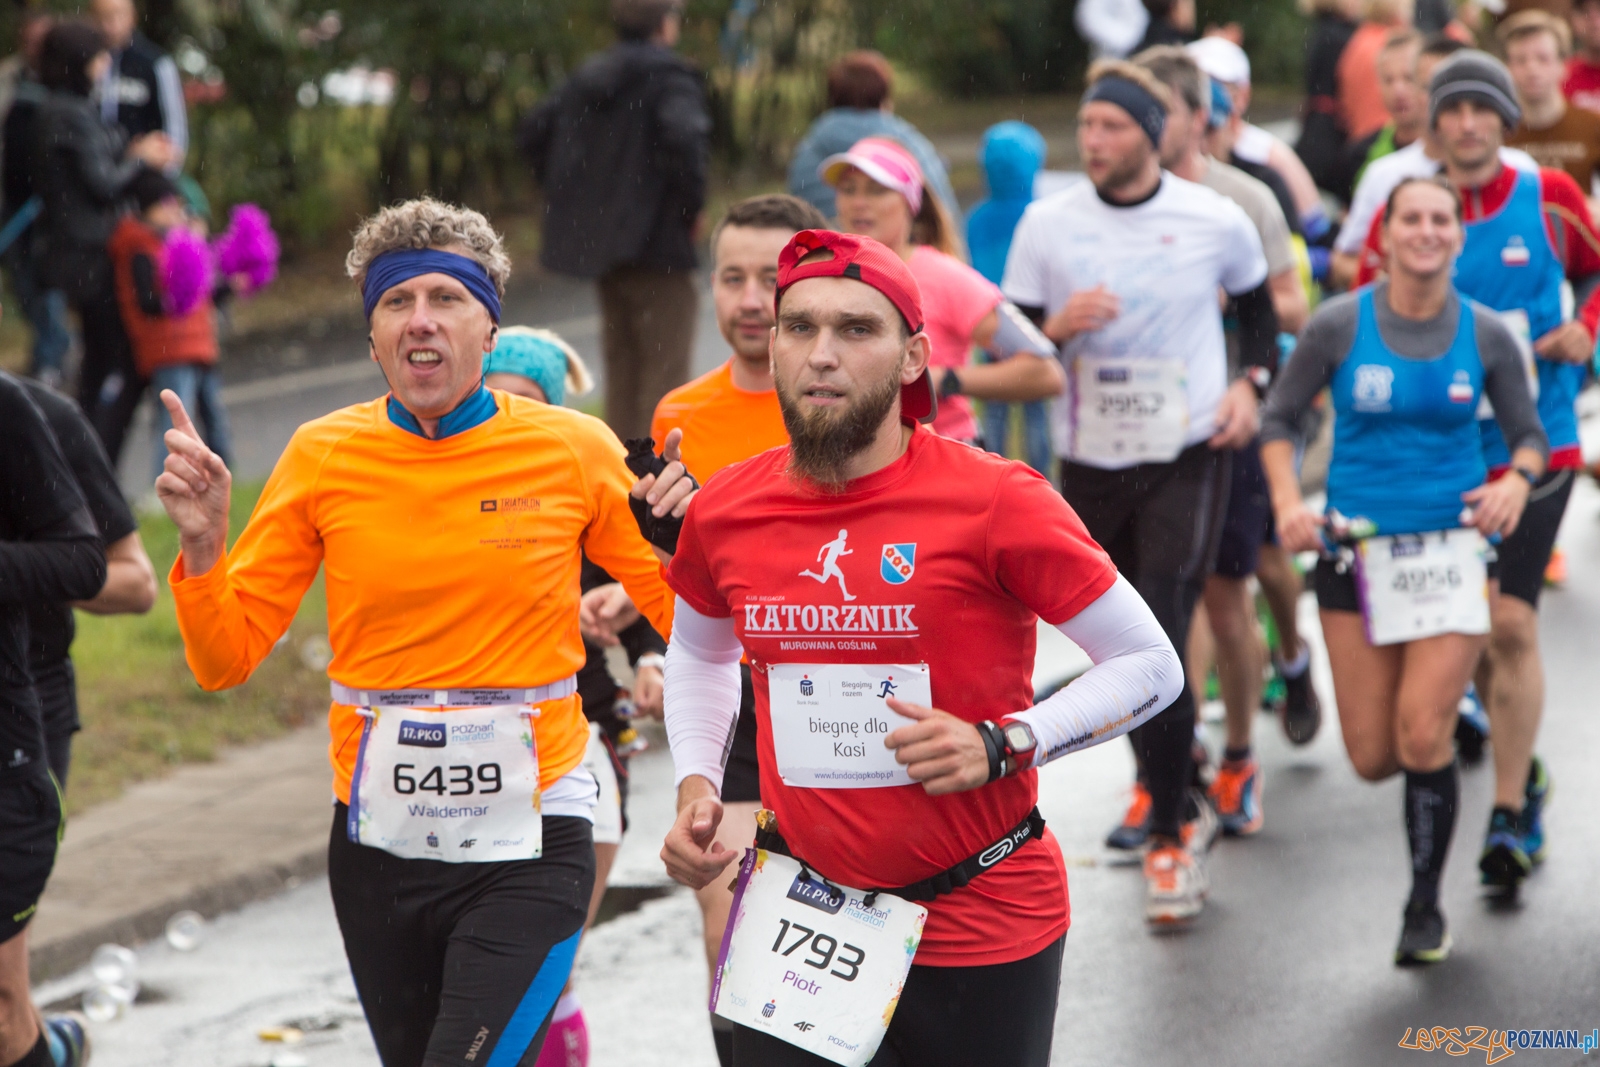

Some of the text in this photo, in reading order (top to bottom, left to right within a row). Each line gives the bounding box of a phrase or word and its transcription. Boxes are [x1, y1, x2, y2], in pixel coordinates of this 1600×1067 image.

[501, 498, 540, 508] TRIATHLON
[780, 639, 877, 651] MUROWANA GOŚLINA
[841, 681, 872, 690] Biegajmy
[379, 692, 430, 702] performance
[809, 717, 888, 738] biegnę dla
[451, 732, 494, 742] maraton
[833, 742, 866, 757] Kasi
[394, 762, 502, 796] 6439
[814, 770, 894, 781] www.fundacjapkobp.pl
[408, 804, 489, 818] Waldemar
[844, 906, 886, 929] maraton
[771, 918, 866, 982] 1793
[782, 970, 822, 996] Piotr
[793, 1021, 815, 1032] 4F
[464, 1026, 490, 1062] ACTIVE
